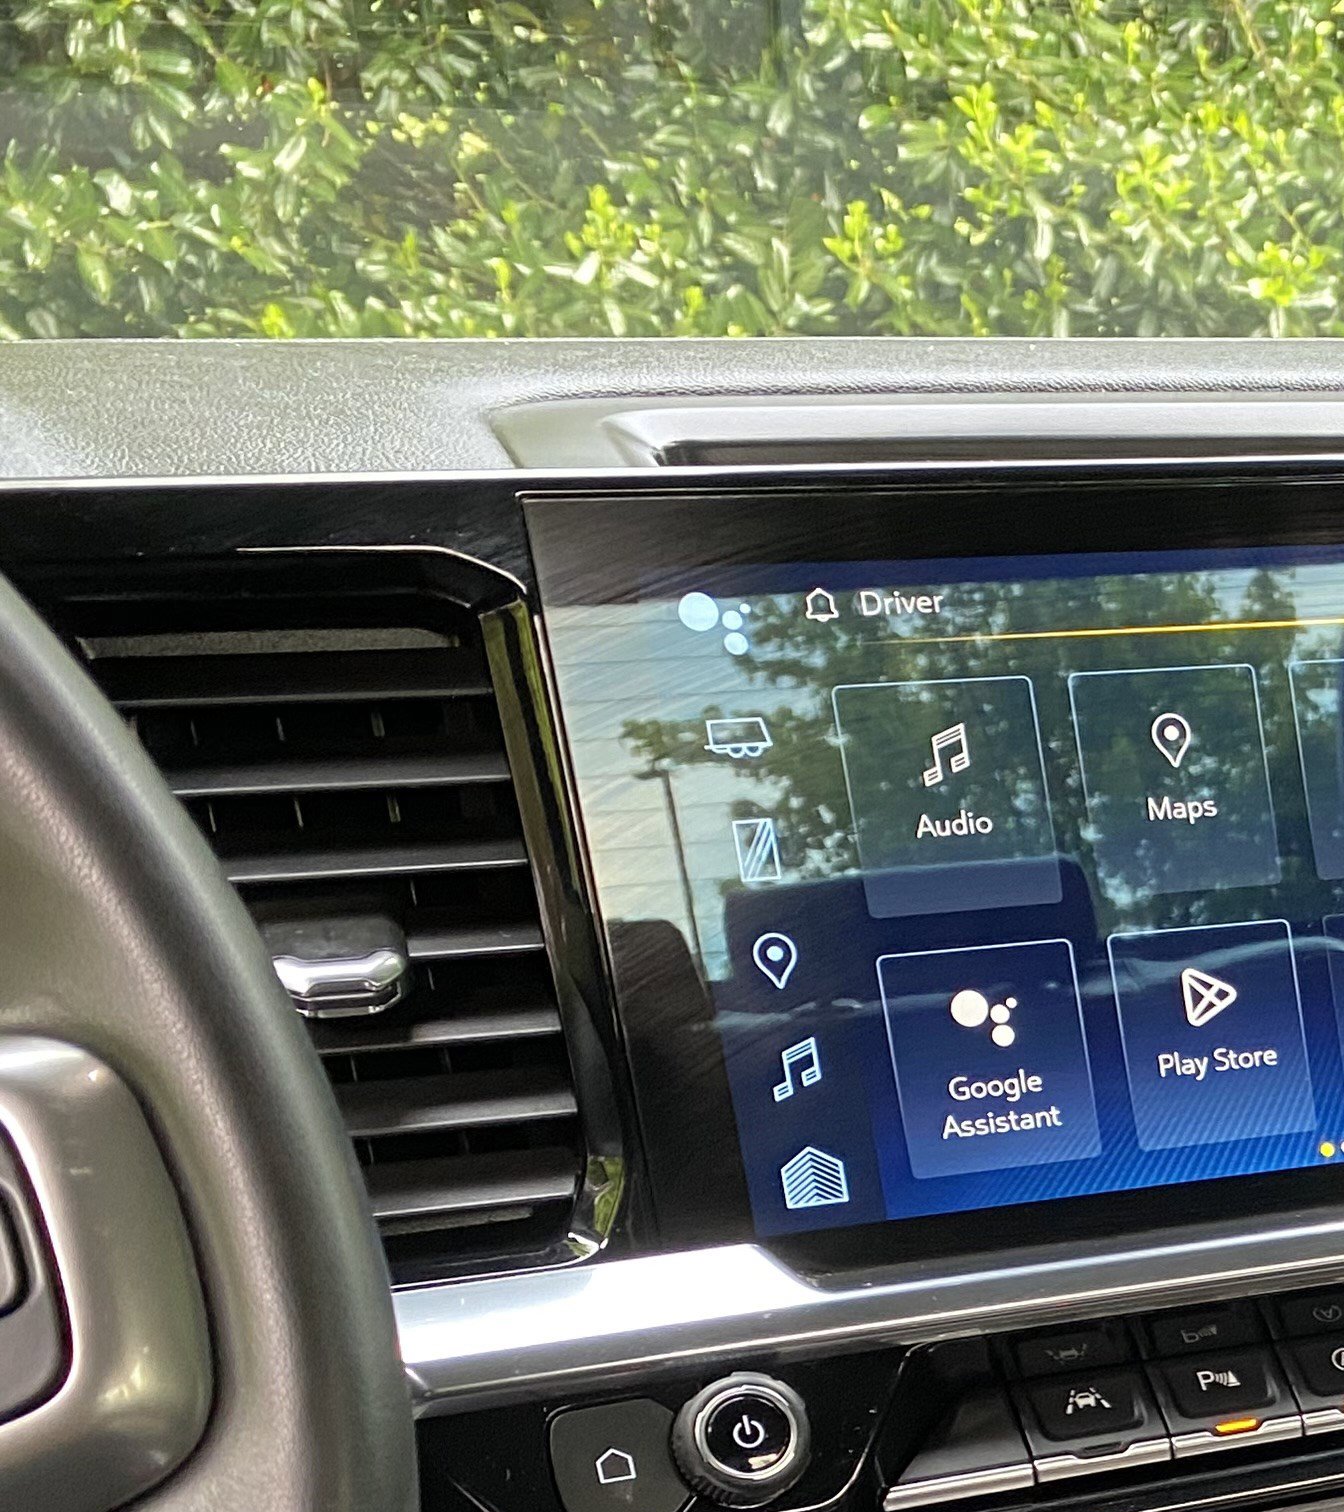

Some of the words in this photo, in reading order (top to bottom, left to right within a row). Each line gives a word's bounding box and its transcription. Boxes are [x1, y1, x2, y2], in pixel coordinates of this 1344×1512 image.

[859, 589, 944, 618] Driver
[915, 810, 993, 838] Audio
[1146, 795, 1218, 827] Maps
[1157, 1051, 1209, 1082] Play
[1215, 1047, 1278, 1072] Store
[948, 1069, 1043, 1103] Google
[942, 1105, 1063, 1140] Assistant
